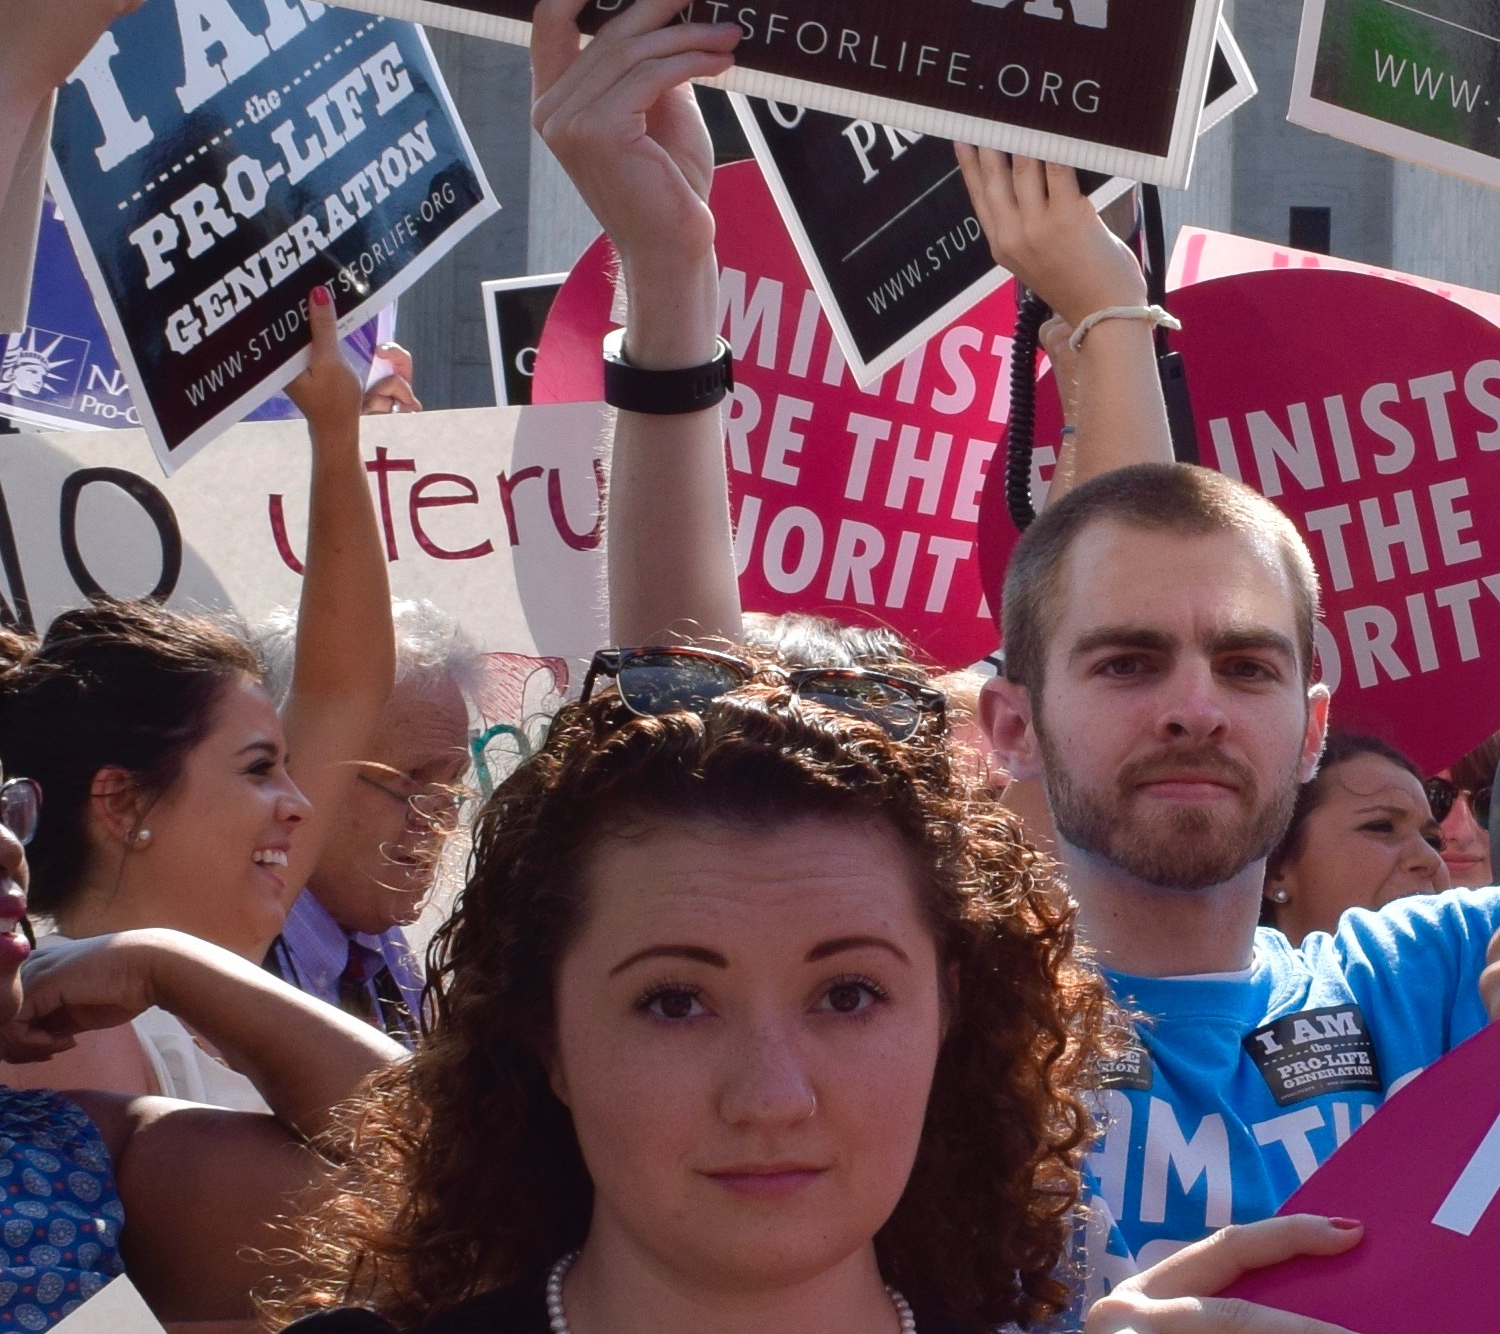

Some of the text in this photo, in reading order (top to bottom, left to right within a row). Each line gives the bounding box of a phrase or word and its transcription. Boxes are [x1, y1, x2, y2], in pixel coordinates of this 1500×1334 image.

[66, 28, 155, 172] I
[244, 87, 282, 124] the
[129, 40, 415, 290] PRO-LIFE
[164, 120, 436, 357] GENERATION
[722, 383, 814, 488] RE
[1304, 476, 1482, 594] THE
[1255, 1011, 1363, 1056] I AM
[1276, 1051, 1372, 1080] PRO-LIFE
[1309, 1042, 1333, 1055] the
[1283, 1065, 1374, 1090] GENERATION
